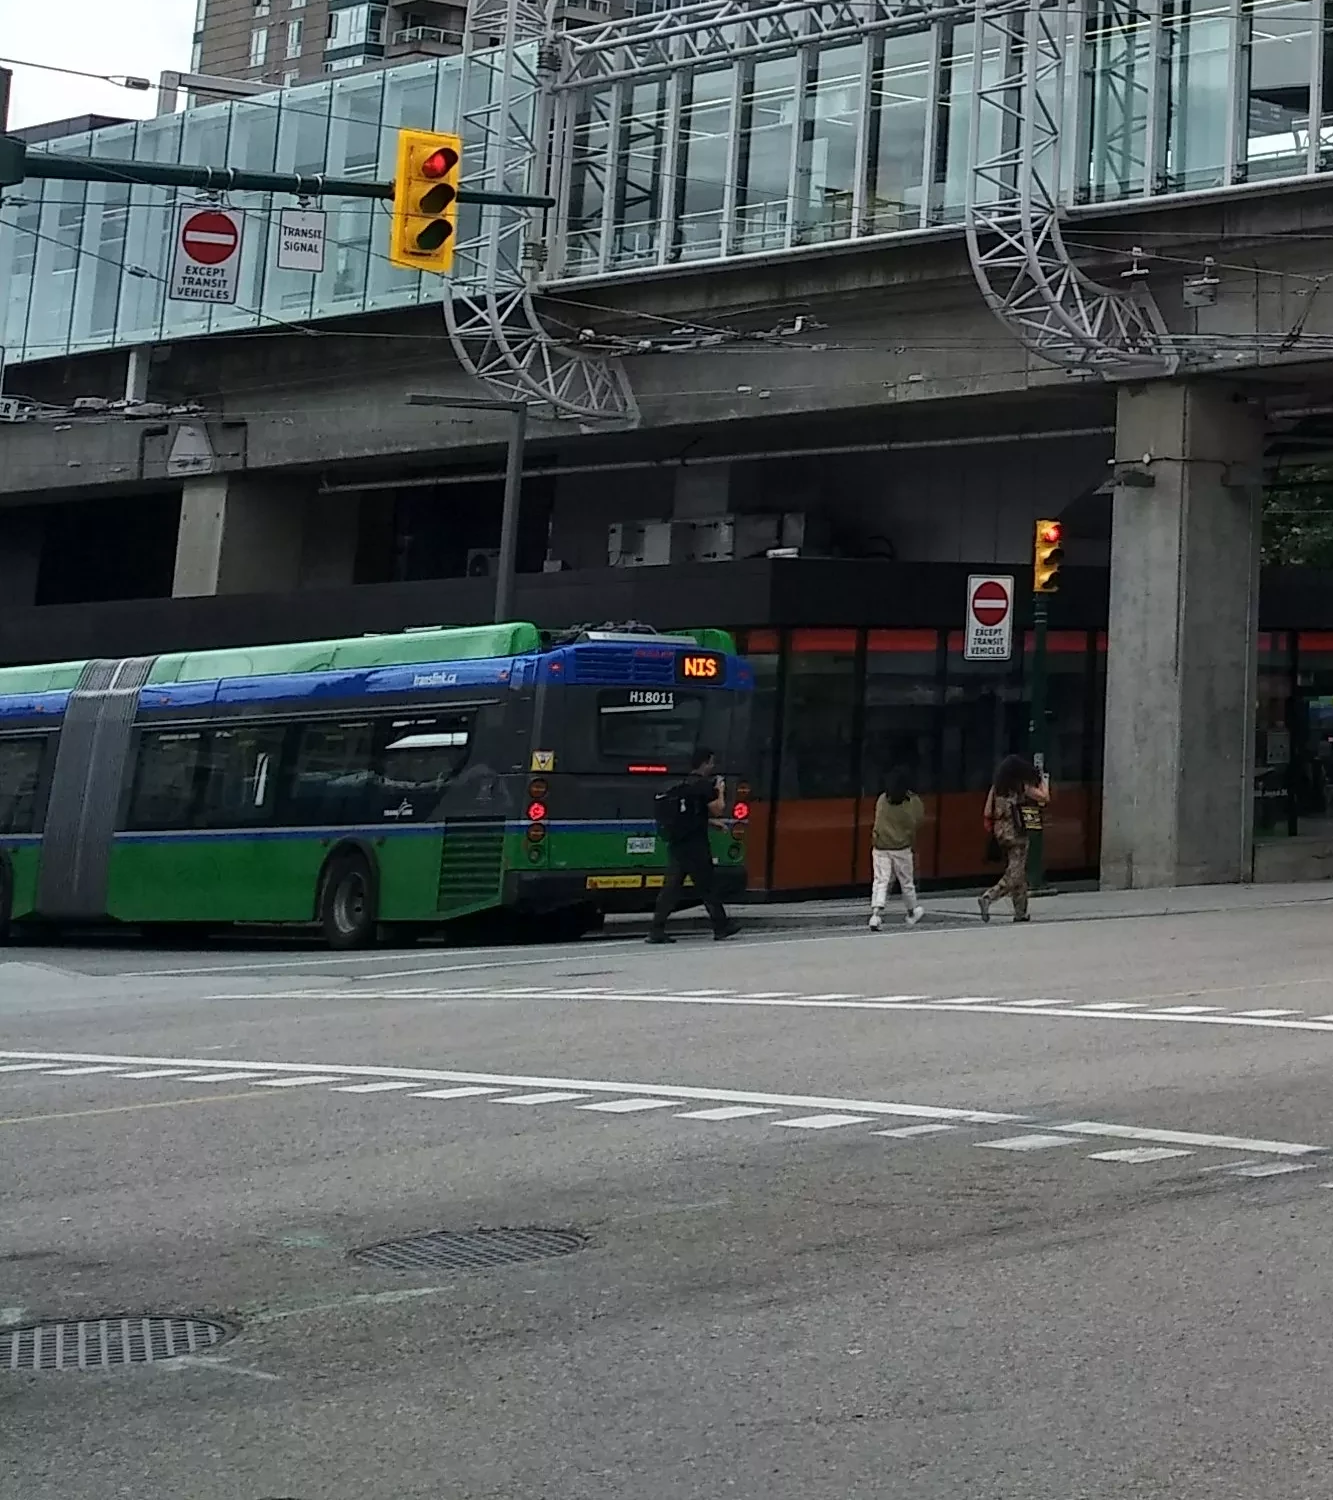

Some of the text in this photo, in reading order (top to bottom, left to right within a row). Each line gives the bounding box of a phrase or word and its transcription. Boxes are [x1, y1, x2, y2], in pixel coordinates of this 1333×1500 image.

[282, 225, 323, 239] TRANSIT
[283, 241, 319, 253] SIGNAL
[185, 265, 226, 277] EXCEPT
[181, 276, 228, 289] TRANSIT
[176, 287, 229, 300] VEHICLES
[975, 628, 1002, 636] EXCEPT
[972, 637, 1004, 646] TRANSIT
[971, 646, 1006, 655] VEHICLES
[684, 657, 717, 677] NIS
[629, 690, 674, 703] H18011
